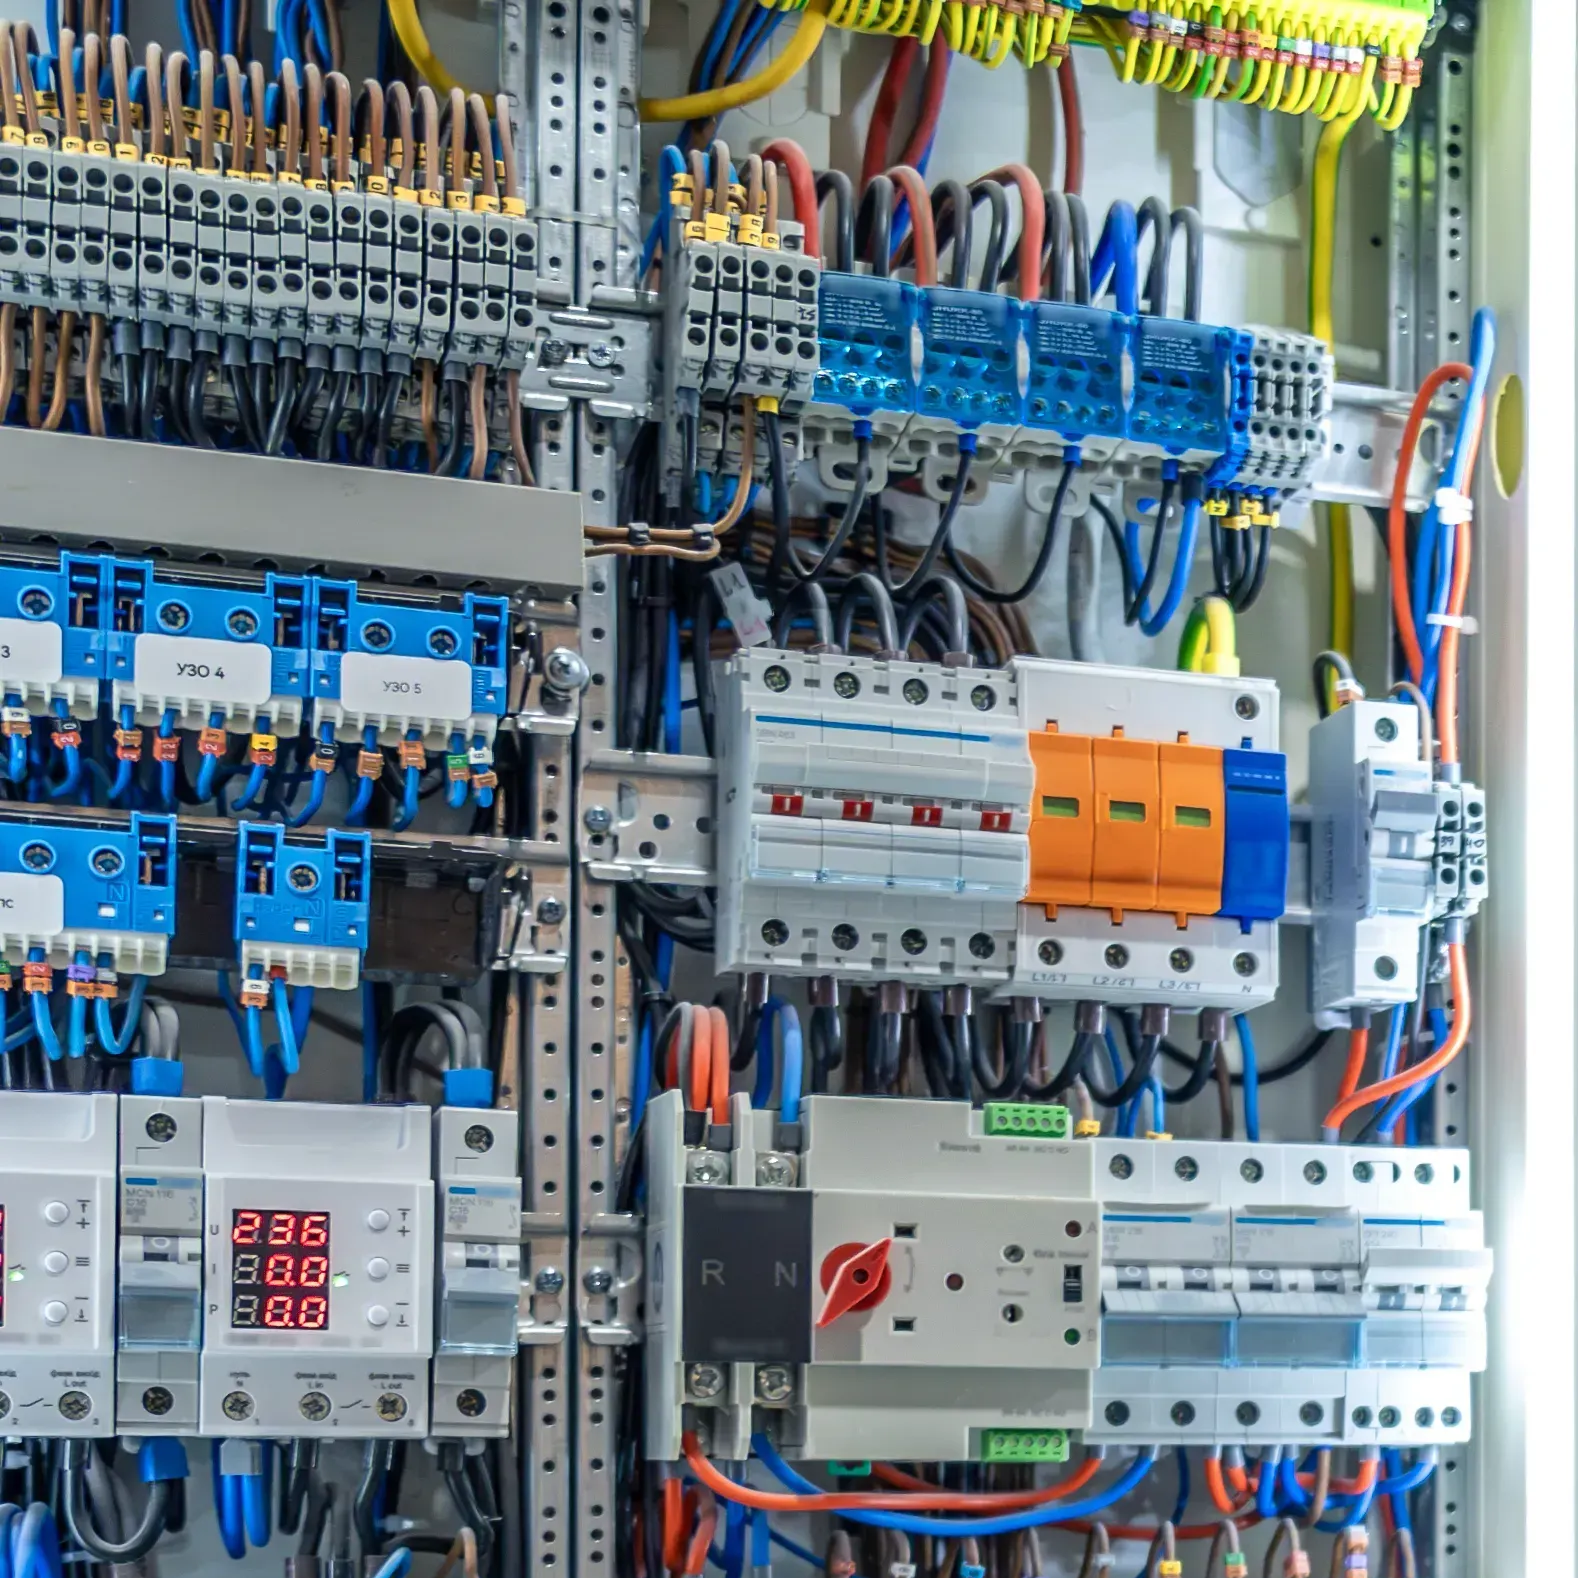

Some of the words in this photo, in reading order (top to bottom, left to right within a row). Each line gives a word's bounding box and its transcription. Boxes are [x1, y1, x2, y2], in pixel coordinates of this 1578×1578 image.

[177, 663, 210, 678] УЗО
[214, 667, 225, 679] 4
[383, 681, 410, 693] УЗО
[413, 683, 422, 694] 5
[210, 1224, 219, 1235] U
[232, 1211, 330, 1247] 236
[702, 1258, 726, 1286] R
[774, 1261, 797, 1288] N
[209, 1304, 219, 1315] P
